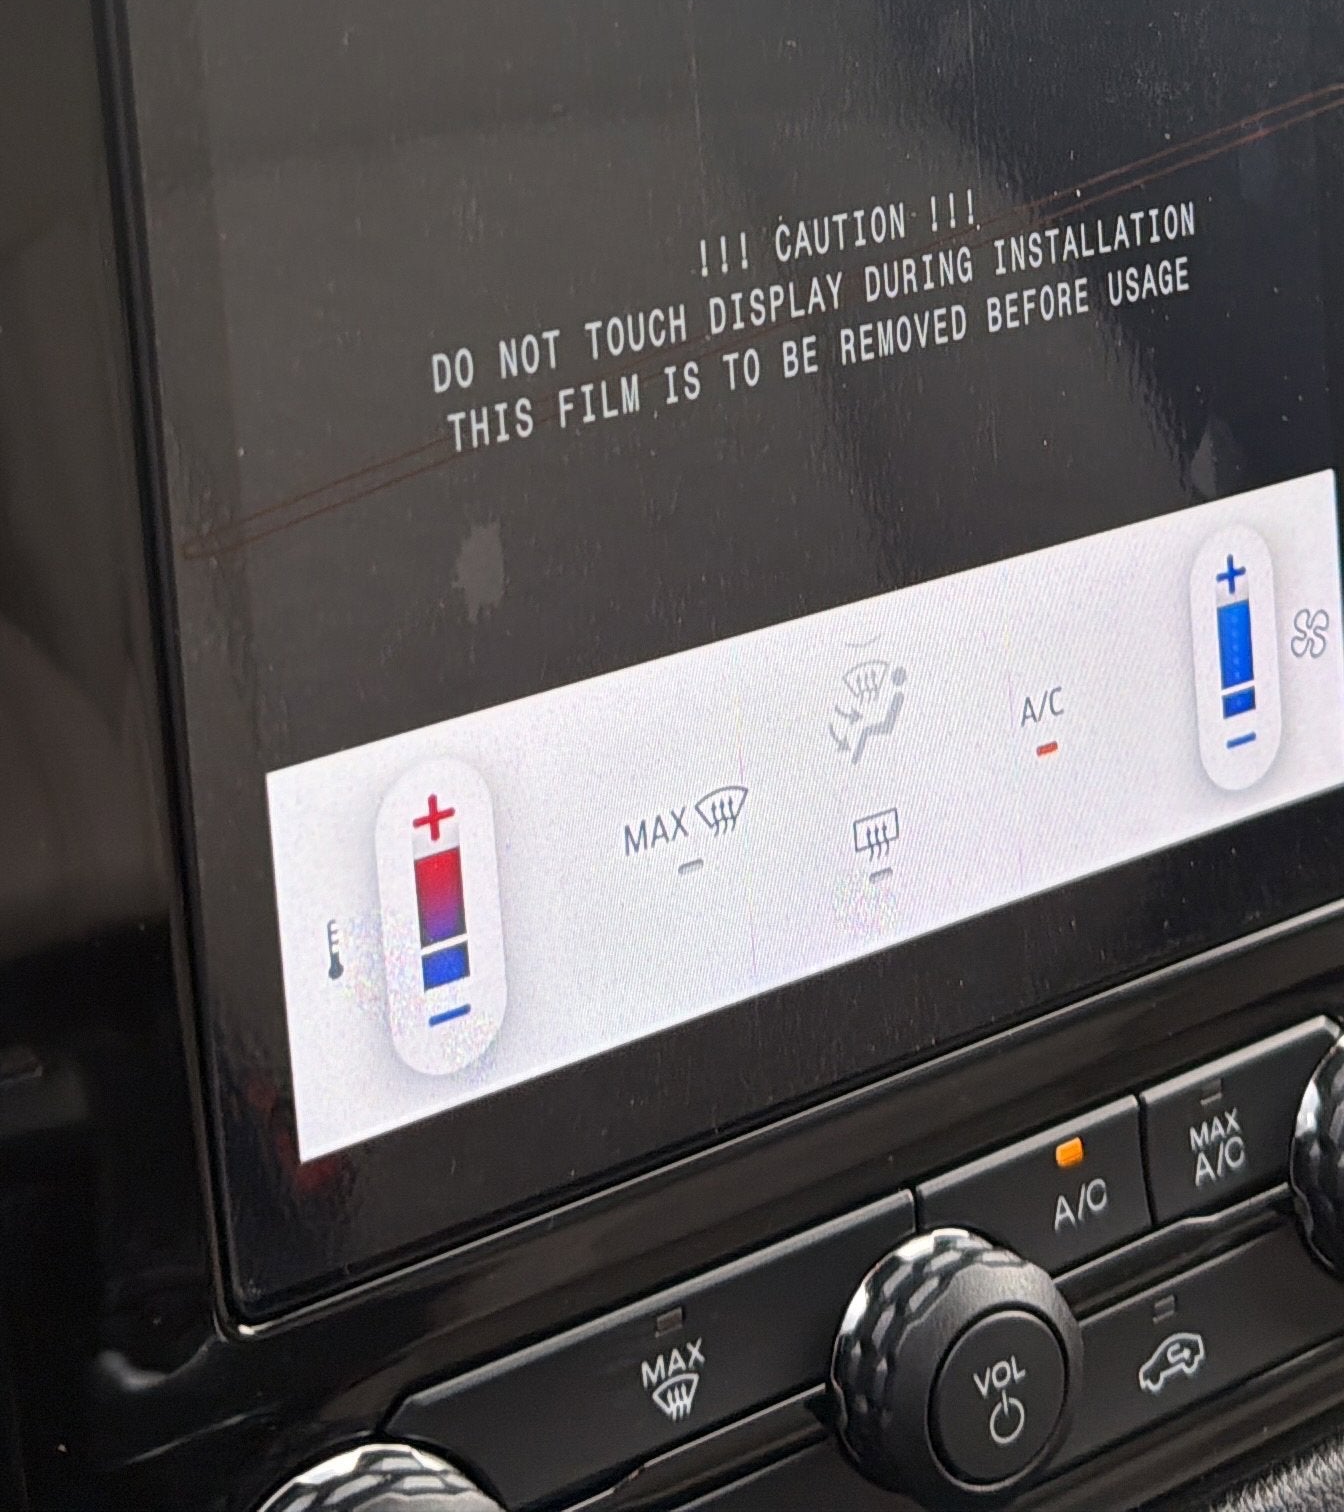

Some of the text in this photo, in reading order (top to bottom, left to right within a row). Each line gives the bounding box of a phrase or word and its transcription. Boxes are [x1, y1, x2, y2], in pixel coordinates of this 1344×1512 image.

[700, 187, 975, 278] !!! CAUTION !!!
[431, 200, 1196, 395] DO NOT TOUCH DISPLAY DURING INSTALLATION
[446, 254, 1191, 453] THIS FILM IS TO BE REMOVED BEFORE USAGE
[1020, 684, 1066, 729] A/C
[623, 805, 690, 858] MAX
[1188, 1106, 1242, 1154] MAX
[1193, 1134, 1247, 1188] A/C
[1053, 1177, 1109, 1233] A/C
[639, 1336, 707, 1390] MAX
[972, 1354, 1027, 1400] VOL
